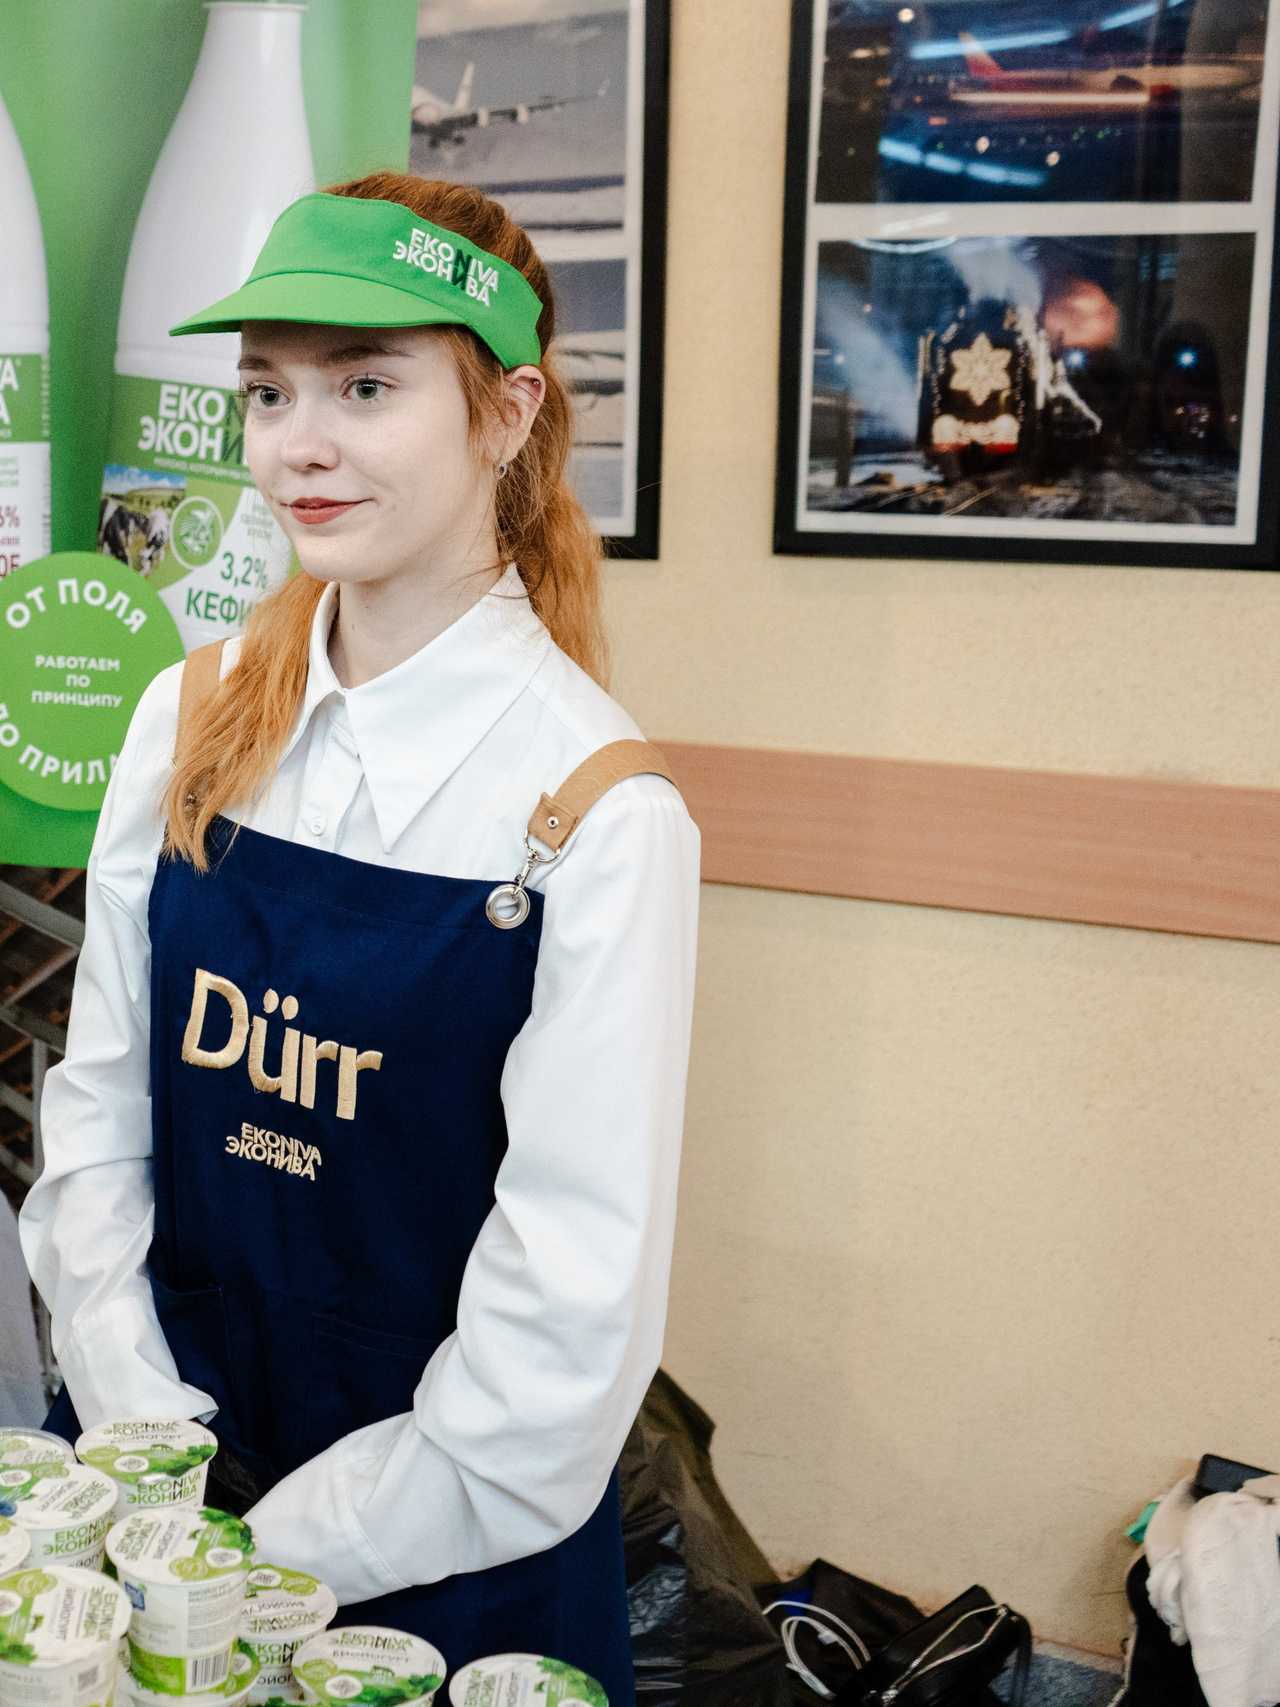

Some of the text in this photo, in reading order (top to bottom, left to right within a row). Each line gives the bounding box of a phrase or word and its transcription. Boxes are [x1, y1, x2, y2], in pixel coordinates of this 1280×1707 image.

[392, 240, 490, 308] ЭКОНИВА
[411, 228, 499, 293] EKONIVA
[138, 416, 249, 467] ЭКОНИ
[221, 552, 268, 589] 3,2%
[5, 578, 148, 634] ОТ ПОЛЯ
[35, 654, 121, 672] РАБОТАЕМ
[66, 674, 91, 688] ПО
[31, 691, 122, 708] ПРИНЦИПУ
[181, 968, 383, 1121] Dürr
[224, 1136, 316, 1181] ЭКОНИВА
[241, 1122, 322, 1166] EKONIVA
[126, 1485, 197, 1504] ЭКОНИВА
[138, 1471, 201, 1493] EKONIVA
